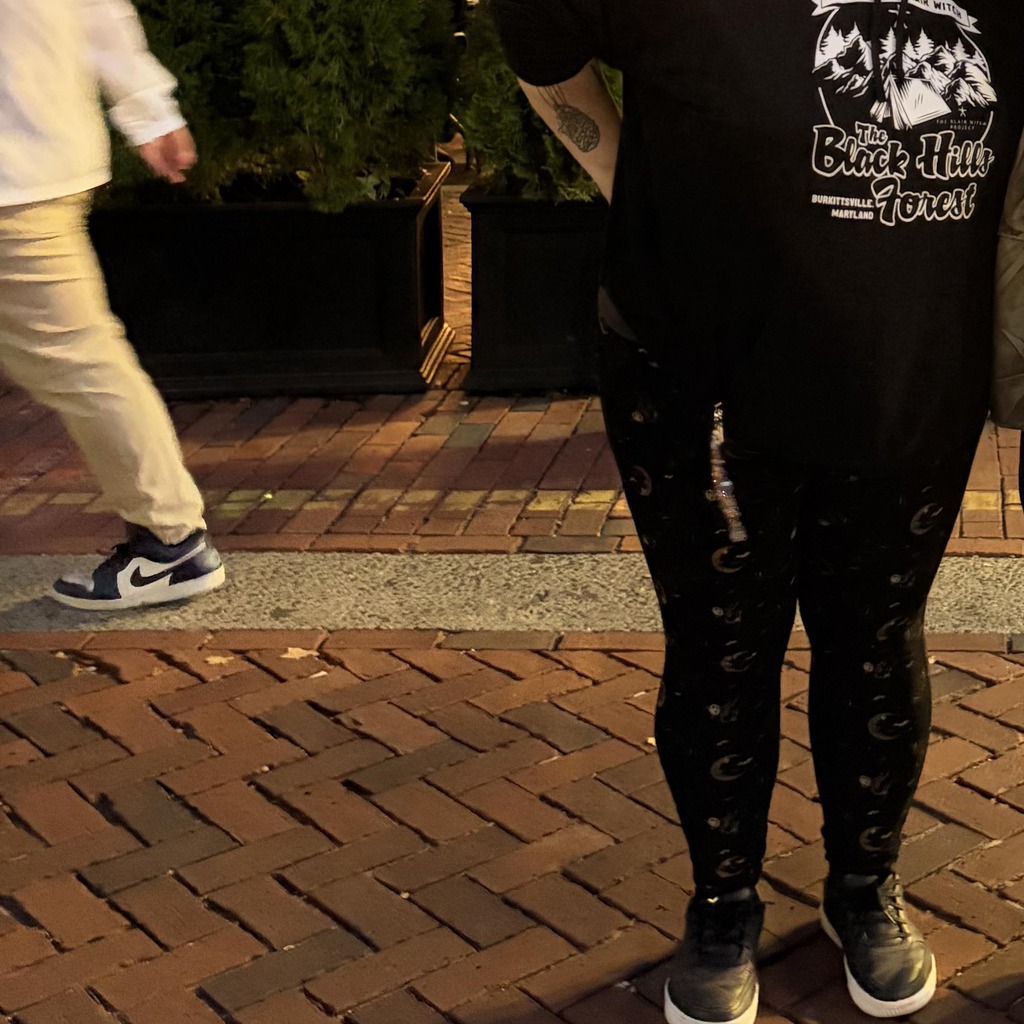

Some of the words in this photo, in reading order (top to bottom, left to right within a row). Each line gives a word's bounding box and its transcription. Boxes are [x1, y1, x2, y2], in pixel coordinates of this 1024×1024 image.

[933, 0, 963, 20] WITCH
[854, 121, 889, 147] The
[811, 124, 911, 179] Black
[915, 130, 995, 181] Hills
[870, 175, 978, 227] Forest
[831, 208, 875, 221] MARYLAND
